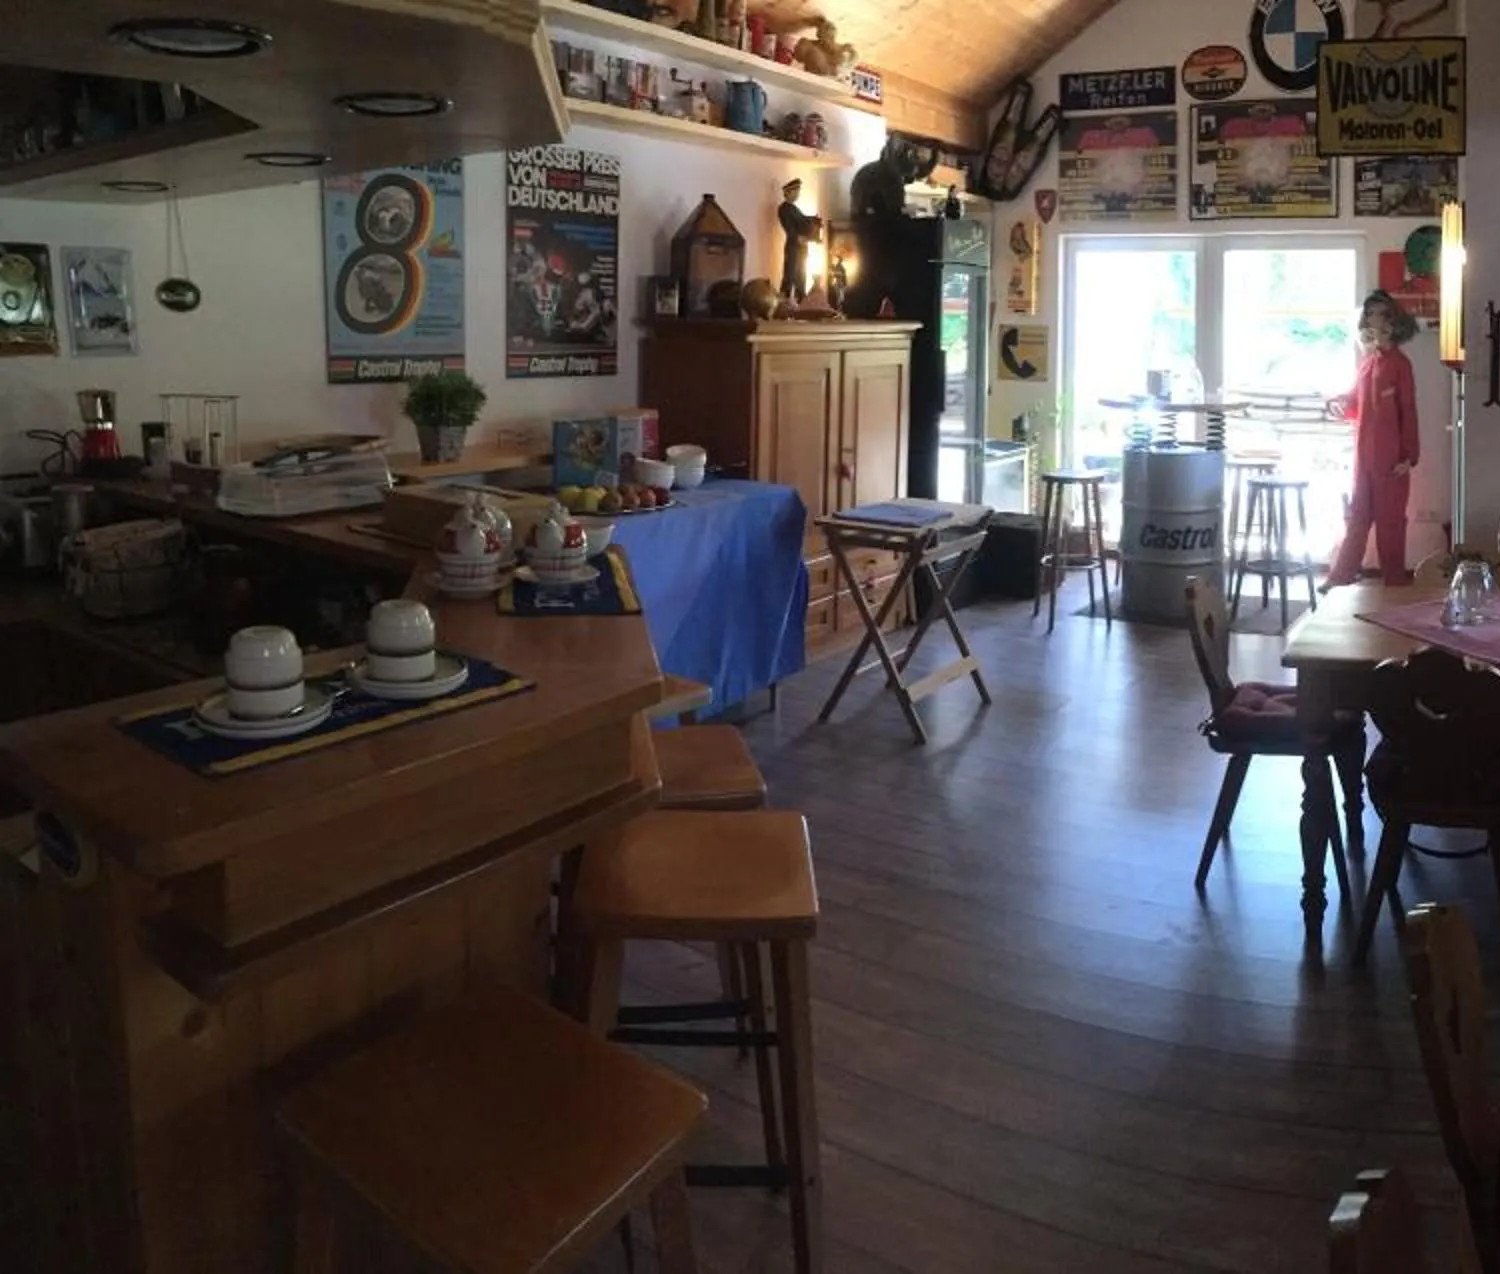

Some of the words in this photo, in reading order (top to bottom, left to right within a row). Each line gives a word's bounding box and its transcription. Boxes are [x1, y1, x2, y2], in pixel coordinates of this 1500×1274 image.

[1068, 72, 1167, 94] METZELER
[1323, 54, 1459, 113] VALVOLINE
[1090, 92, 1147, 108] Reifen
[1338, 117, 1443, 142] Motoren-Oel
[508, 164, 547, 189] VON
[507, 185, 621, 216] DEUTSCHLAND
[1139, 522, 1220, 550] Castrol
